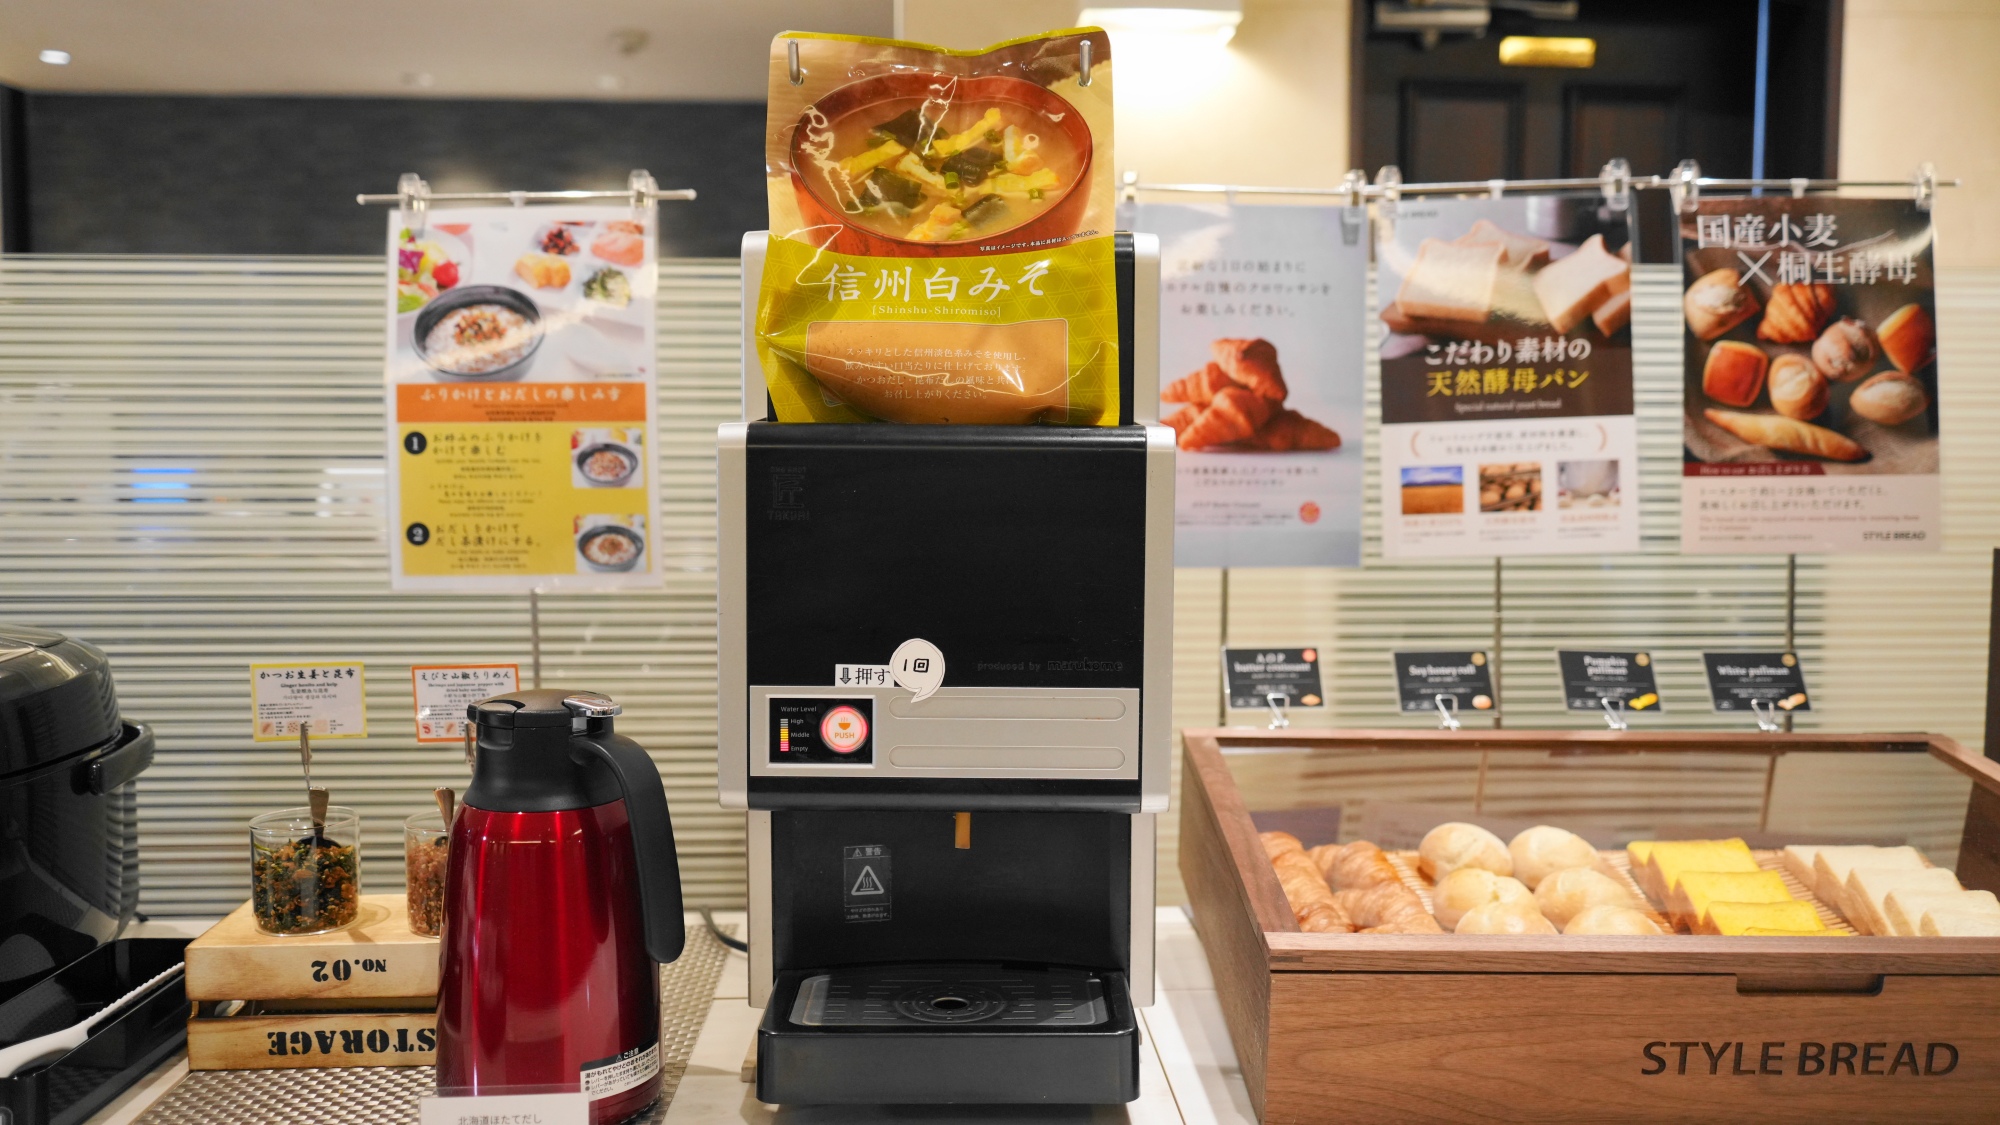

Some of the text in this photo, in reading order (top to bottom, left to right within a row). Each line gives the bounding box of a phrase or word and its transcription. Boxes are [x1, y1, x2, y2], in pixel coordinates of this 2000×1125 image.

[1697, 213, 1839, 249] 国産小麦
[822, 258, 1052, 303] 信州白みそ
[1424, 335, 1592, 366] こだわり素材の
[1426, 367, 1590, 398] 天然酵母パン
[420, 385, 622, 402] ふりかけとおだしの楽しみ方
[884, 388, 989, 400] お召し上がりください。
[411, 436, 420, 451] 1
[433, 446, 506, 456] かけて楽しむ
[412, 526, 424, 542] 2
[436, 523, 521, 534] おだしをかけて
[1863, 530, 1926, 541] STYLE BREAD
[977, 656, 1124, 673] produced by marukome
[1233, 661, 1311, 673] butter croissant
[1583, 655, 1628, 667] Pumpkin
[260, 668, 356, 680] かつお生姜と昆布
[421, 671, 511, 681] えびと山椒ちりめん
[855, 667, 892, 686] 押す
[1717, 665, 1790, 678] White pullman
[267, 1028, 436, 1056] STORAGE
[623, 1047, 640, 1059] ご注意
[1641, 1041, 1960, 1076] STYLE BREAD
[458, 1114, 542, 1125] 北海道ほたてだし
